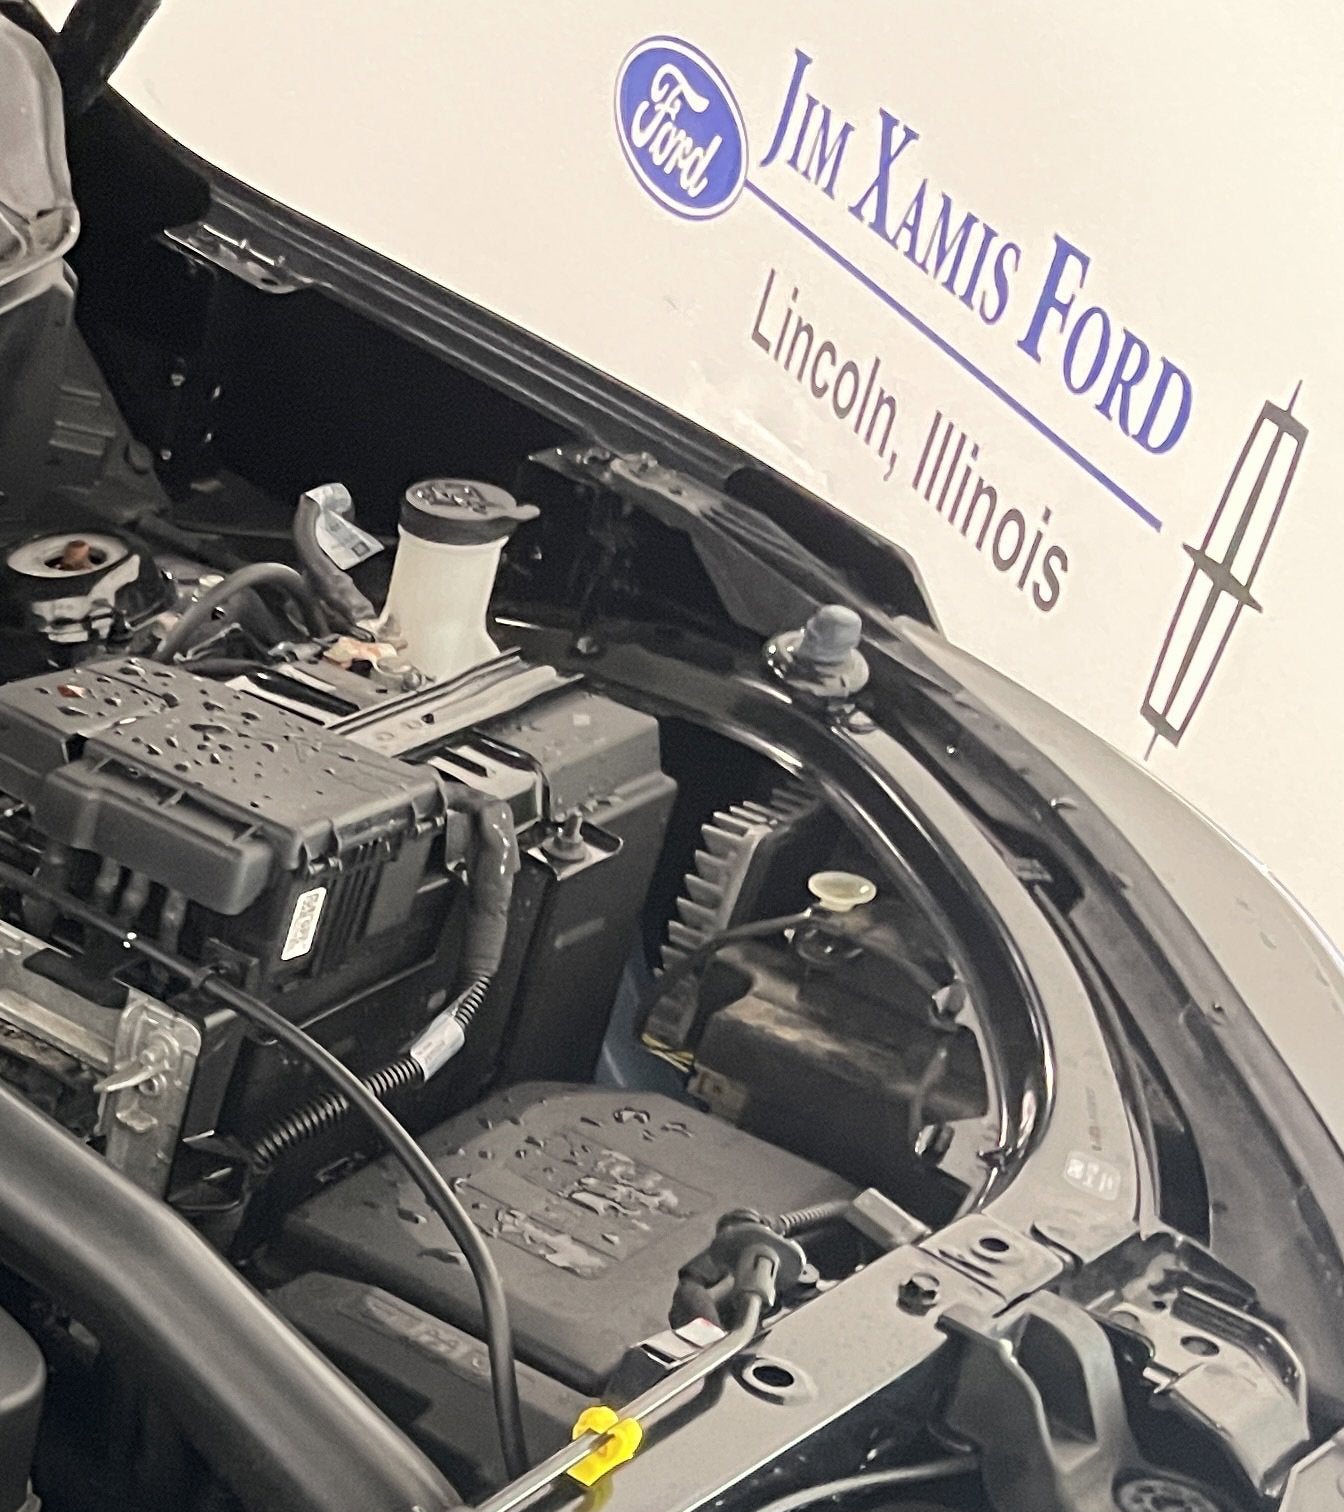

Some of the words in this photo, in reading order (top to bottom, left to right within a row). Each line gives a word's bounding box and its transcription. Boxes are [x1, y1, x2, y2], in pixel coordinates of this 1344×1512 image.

[631, 63, 722, 197] Ford
[759, 48, 855, 199] JIM
[848, 106, 1020, 326] XAMIS
[1017, 232, 1195, 456] FORD
[750, 268, 902, 482] Lincoln,
[911, 410, 1071, 613] Illinois
